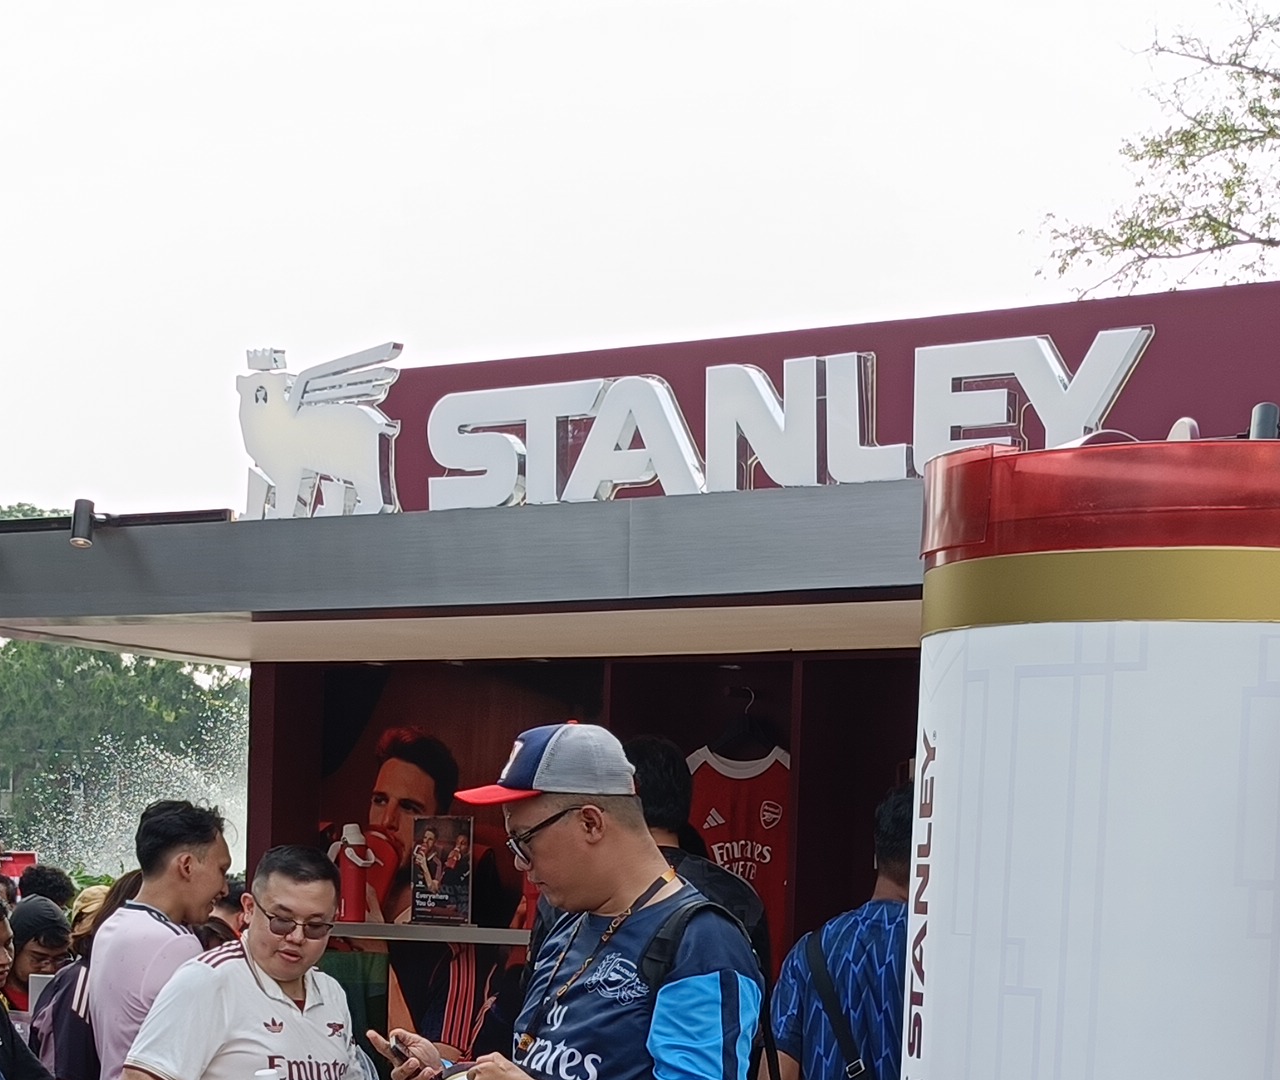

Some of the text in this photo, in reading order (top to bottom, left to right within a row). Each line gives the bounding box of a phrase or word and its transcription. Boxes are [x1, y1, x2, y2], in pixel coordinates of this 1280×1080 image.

[427, 326, 1154, 509] STANLEY
[415, 891, 449, 902] Everywhere
[416, 899, 436, 907] You Go
[907, 728, 937, 1060] STANLEY
